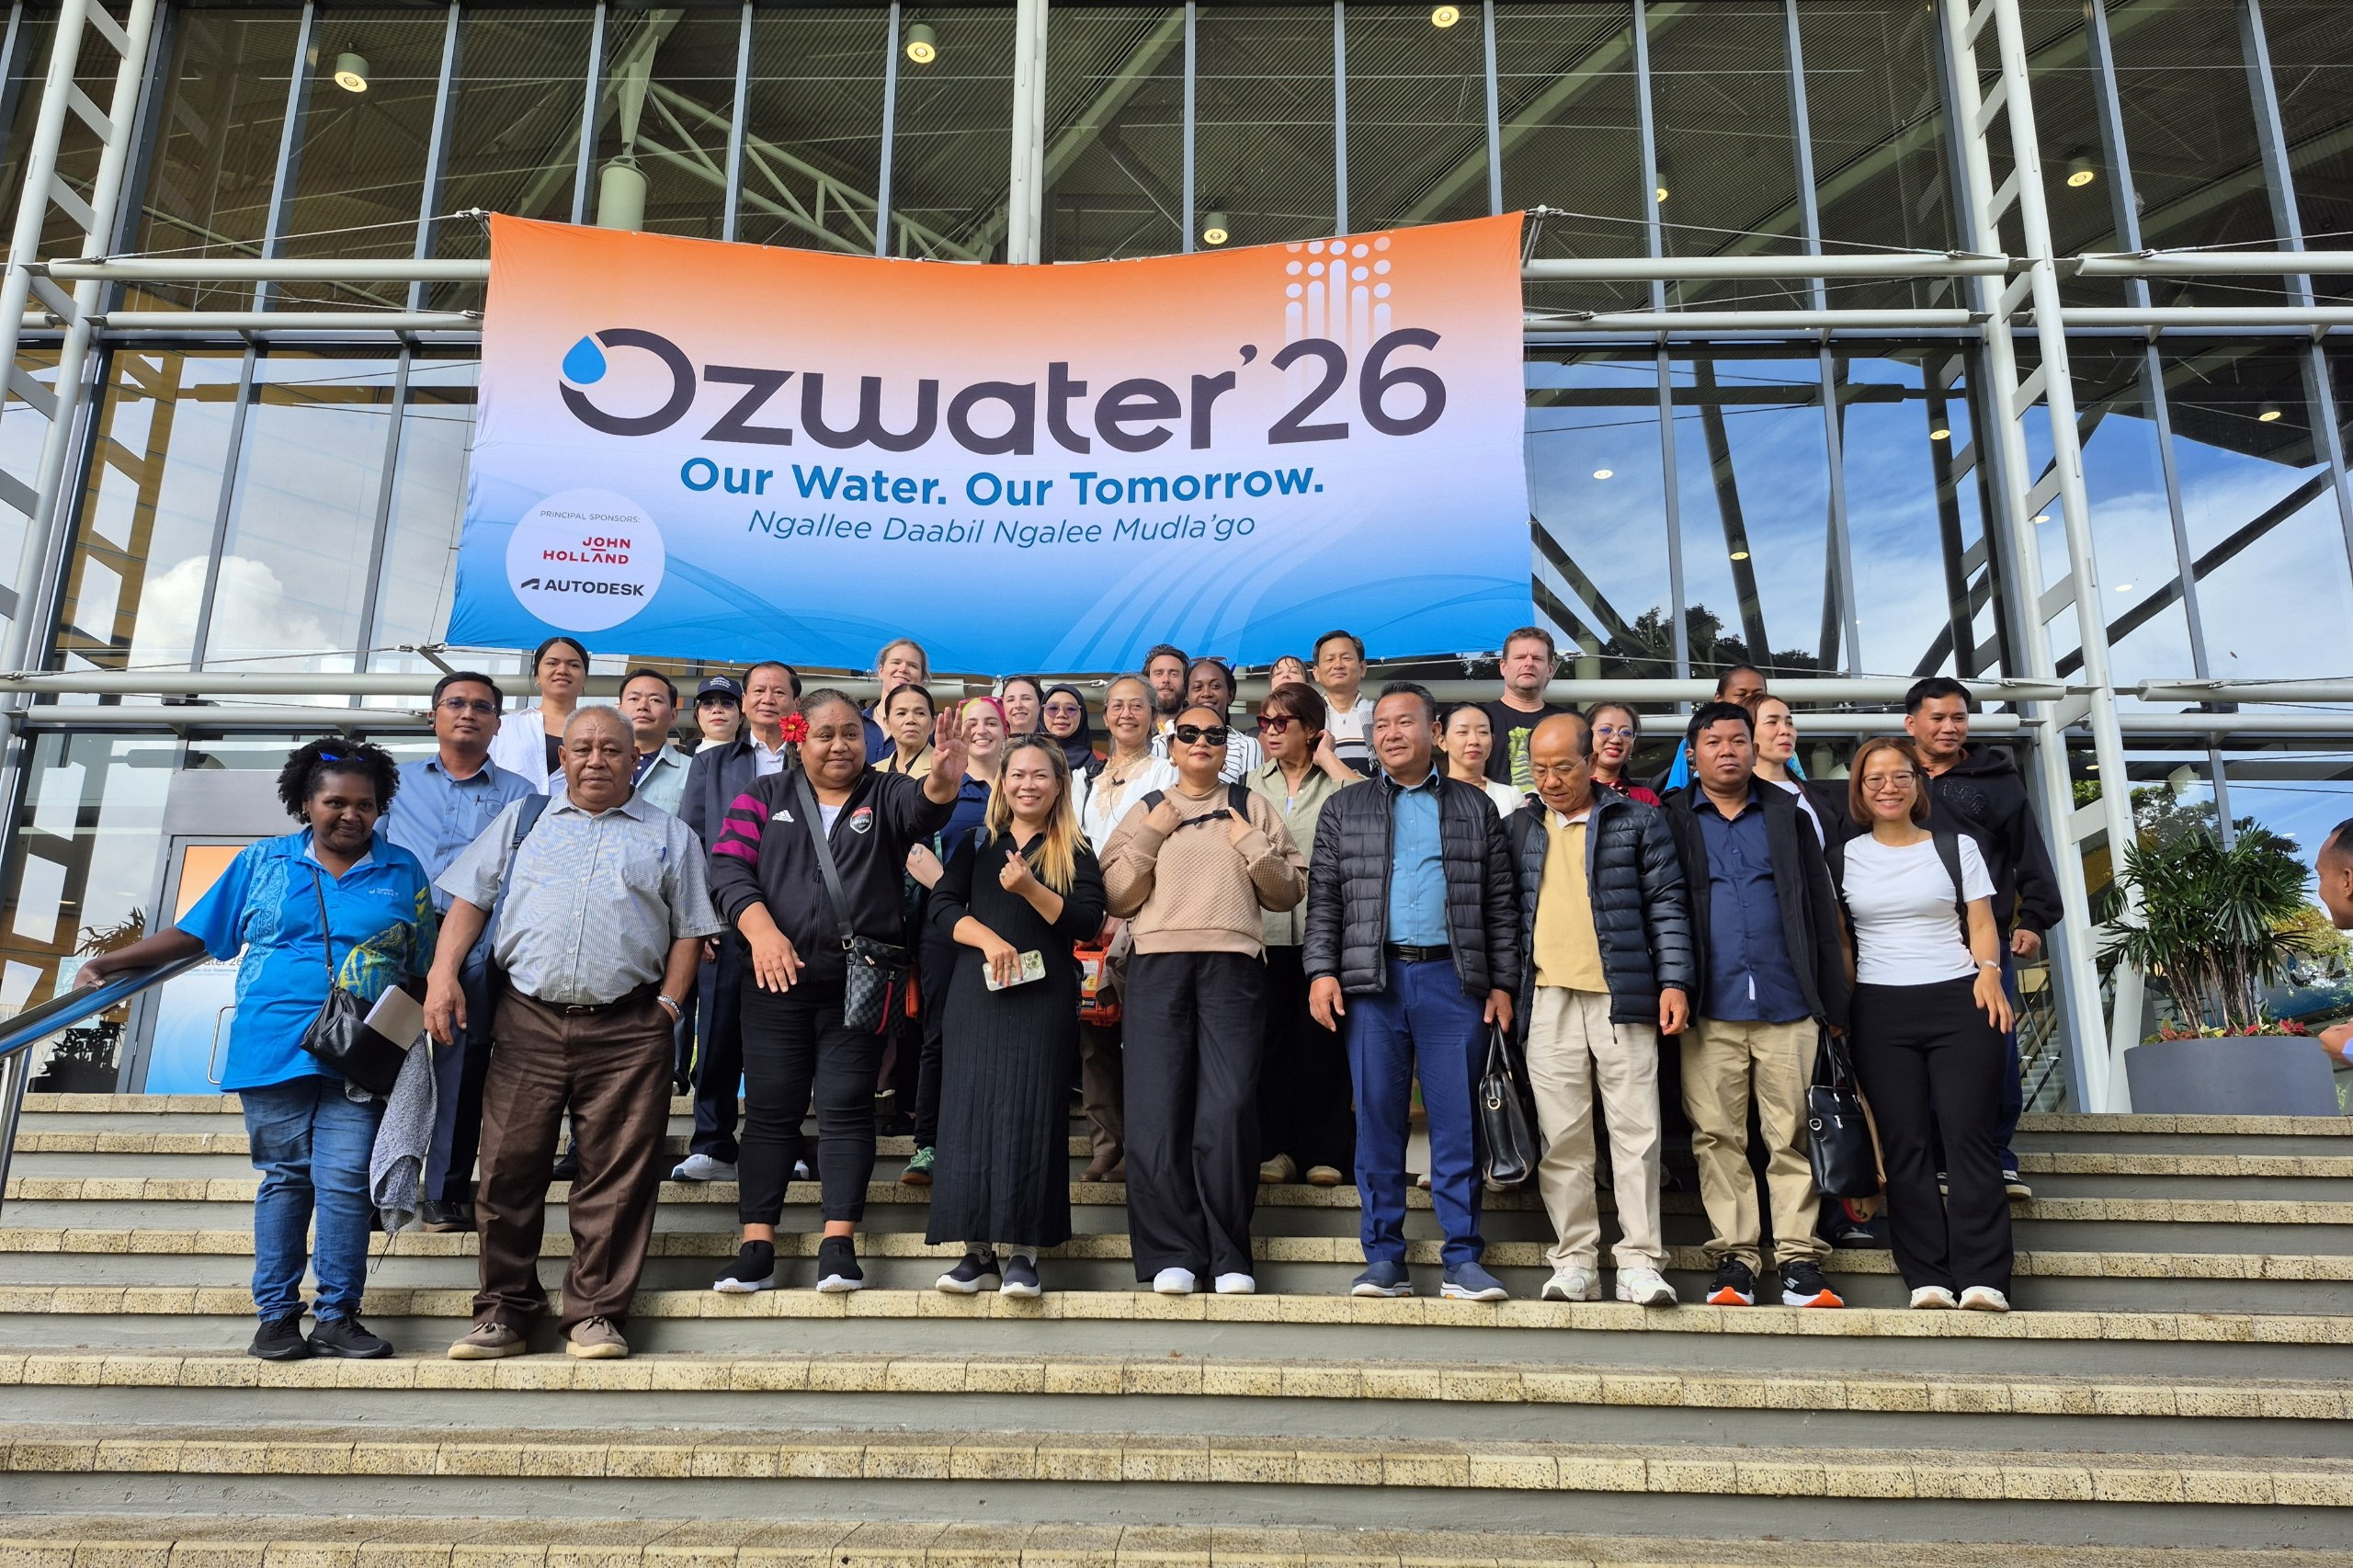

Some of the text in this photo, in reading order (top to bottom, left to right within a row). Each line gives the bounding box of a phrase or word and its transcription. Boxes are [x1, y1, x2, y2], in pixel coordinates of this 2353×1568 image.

[559, 327, 1447, 456] Ozwater'26
[680, 457, 1324, 506] Our Water. Our Tomorrow.
[540, 510, 641, 523] PRINCIPAL SPONSORS:
[748, 509, 1256, 549] Ngallee Daabil Ngalee Mudla'go
[582, 537, 631, 549] JOHN
[542, 550, 630, 564] HOLLAND
[544, 579, 645, 597] AUTODESK
